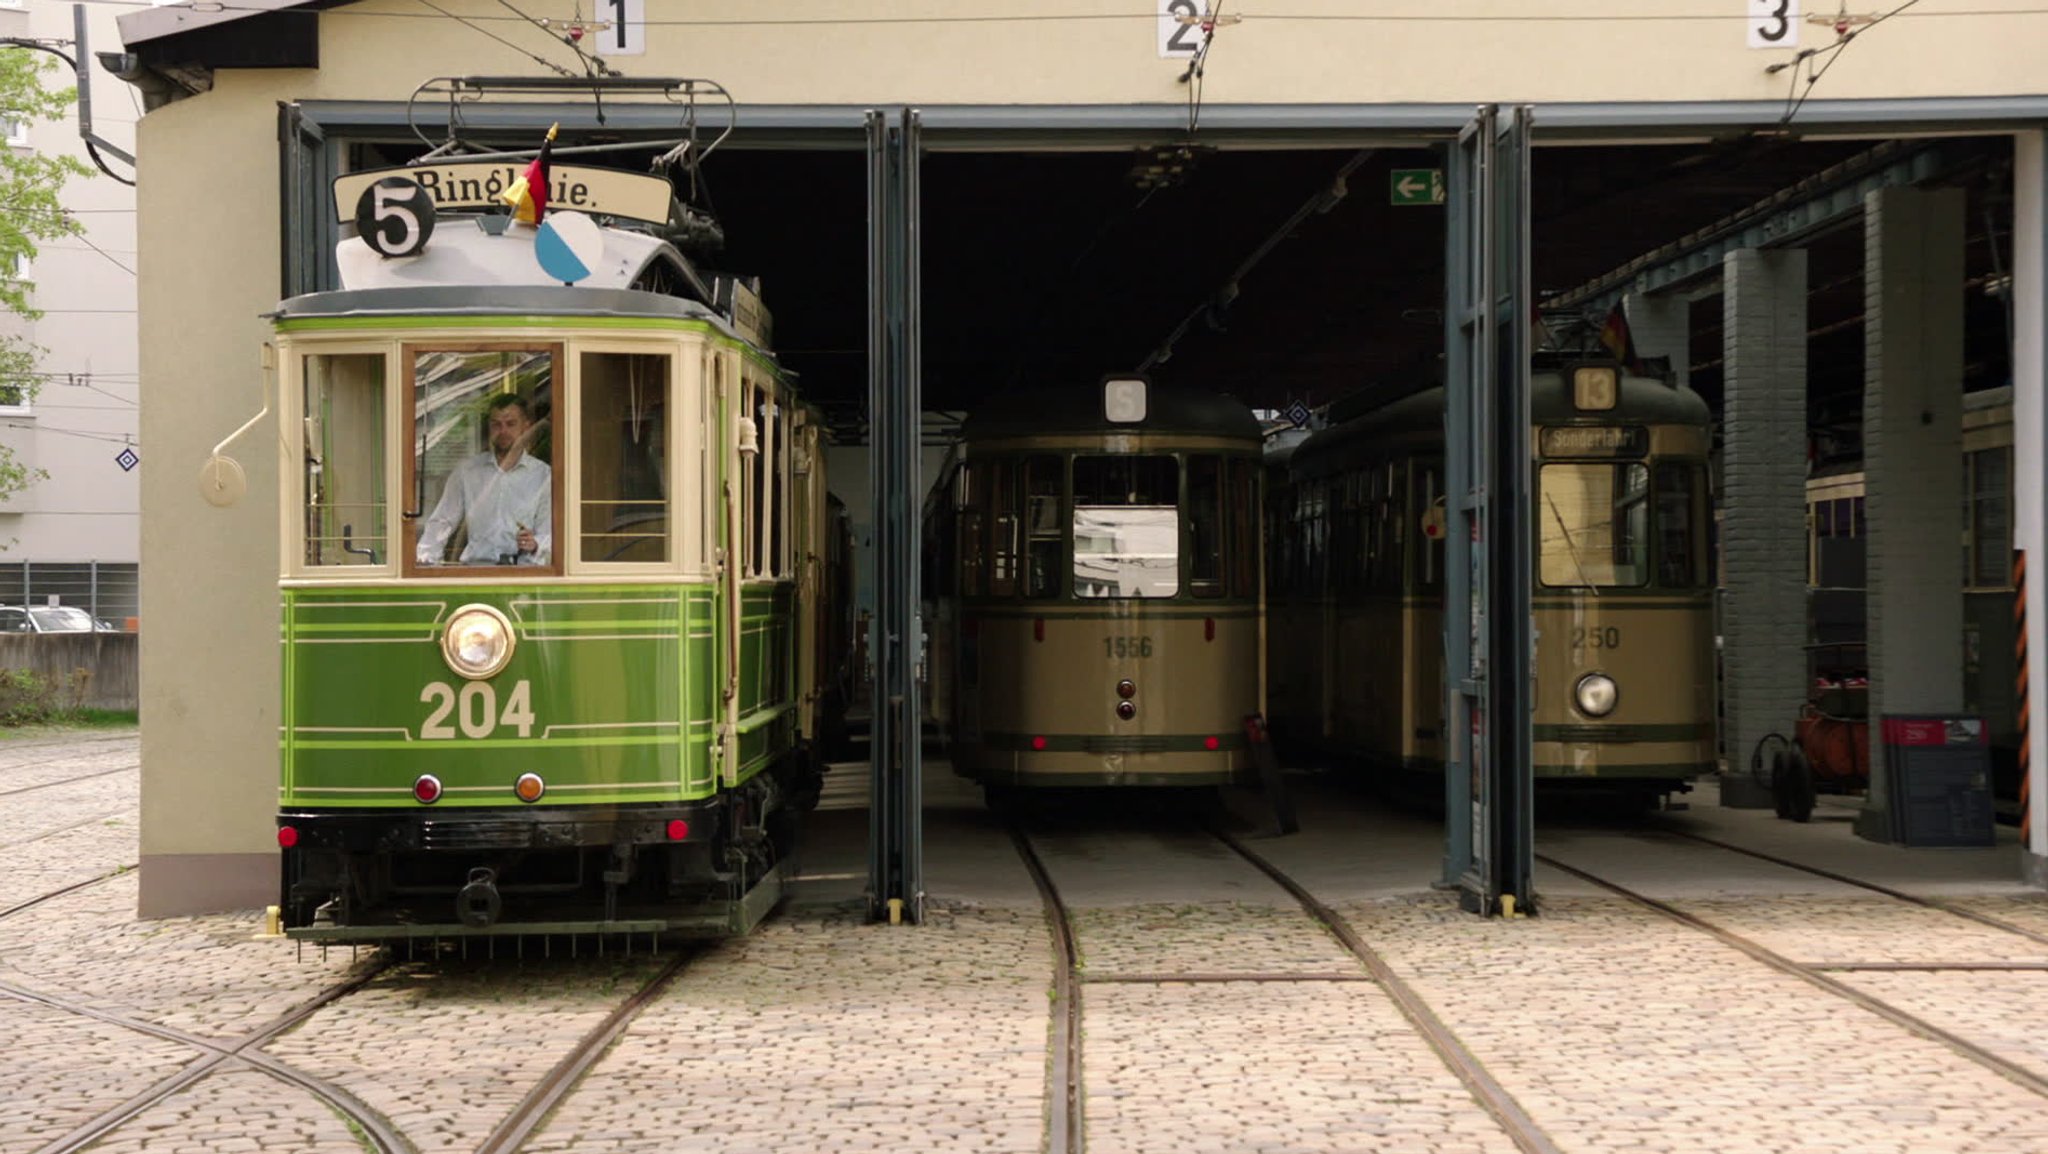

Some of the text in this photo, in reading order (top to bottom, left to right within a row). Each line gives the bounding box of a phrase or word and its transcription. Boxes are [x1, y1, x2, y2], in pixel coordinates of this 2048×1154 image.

[609, 0, 626, 49] 1
[1167, 0, 1198, 51] 2
[1758, 0, 1789, 42] 3
[413, 167, 598, 208] Ringlie.
[373, 184, 420, 256] 5
[1579, 371, 1610, 407] 13
[1104, 635, 1153, 659] 1556
[1571, 626, 1620, 650] 250
[420, 680, 536, 740] 204
